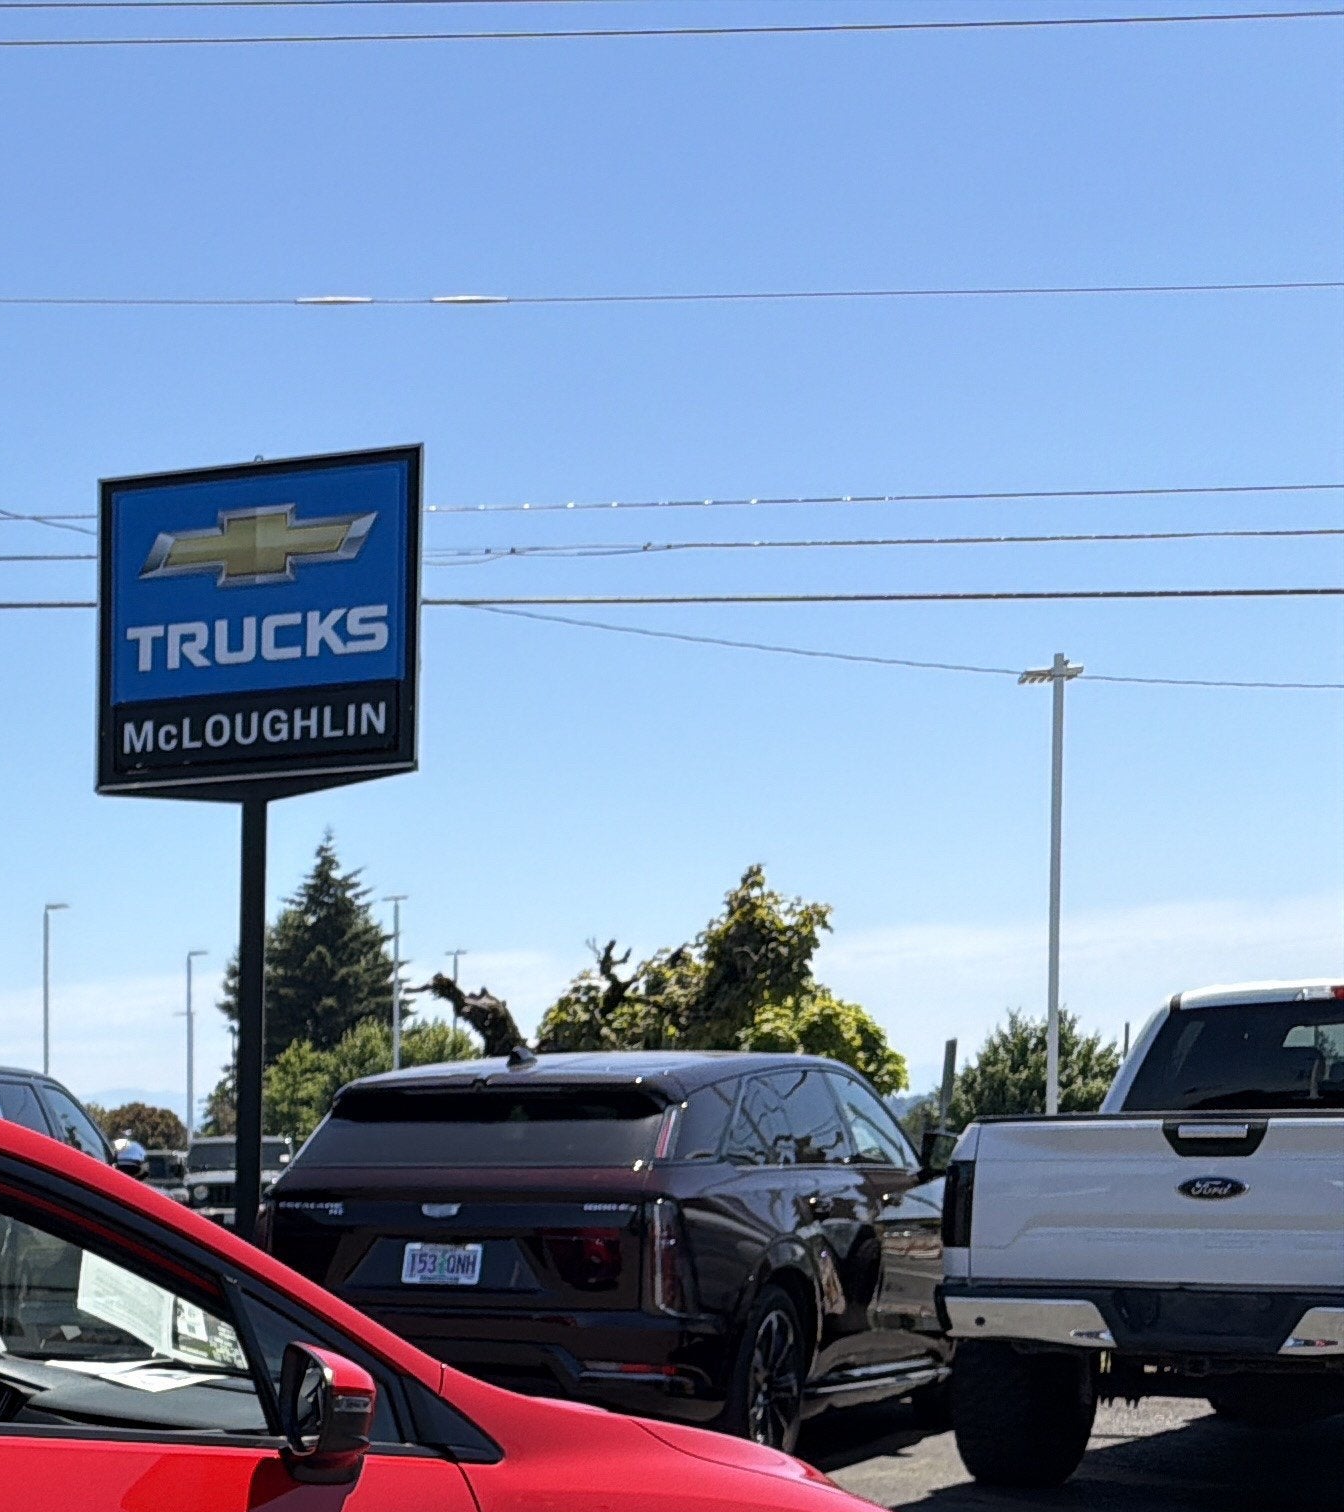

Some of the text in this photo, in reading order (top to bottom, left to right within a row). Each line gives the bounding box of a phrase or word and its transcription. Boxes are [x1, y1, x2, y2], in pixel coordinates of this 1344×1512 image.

[126, 604, 389, 672] TRUCKS
[123, 701, 386, 755] McLOUGHLIN
[1191, 1180, 1232, 1195] Ford
[410, 1253, 437, 1274] 153
